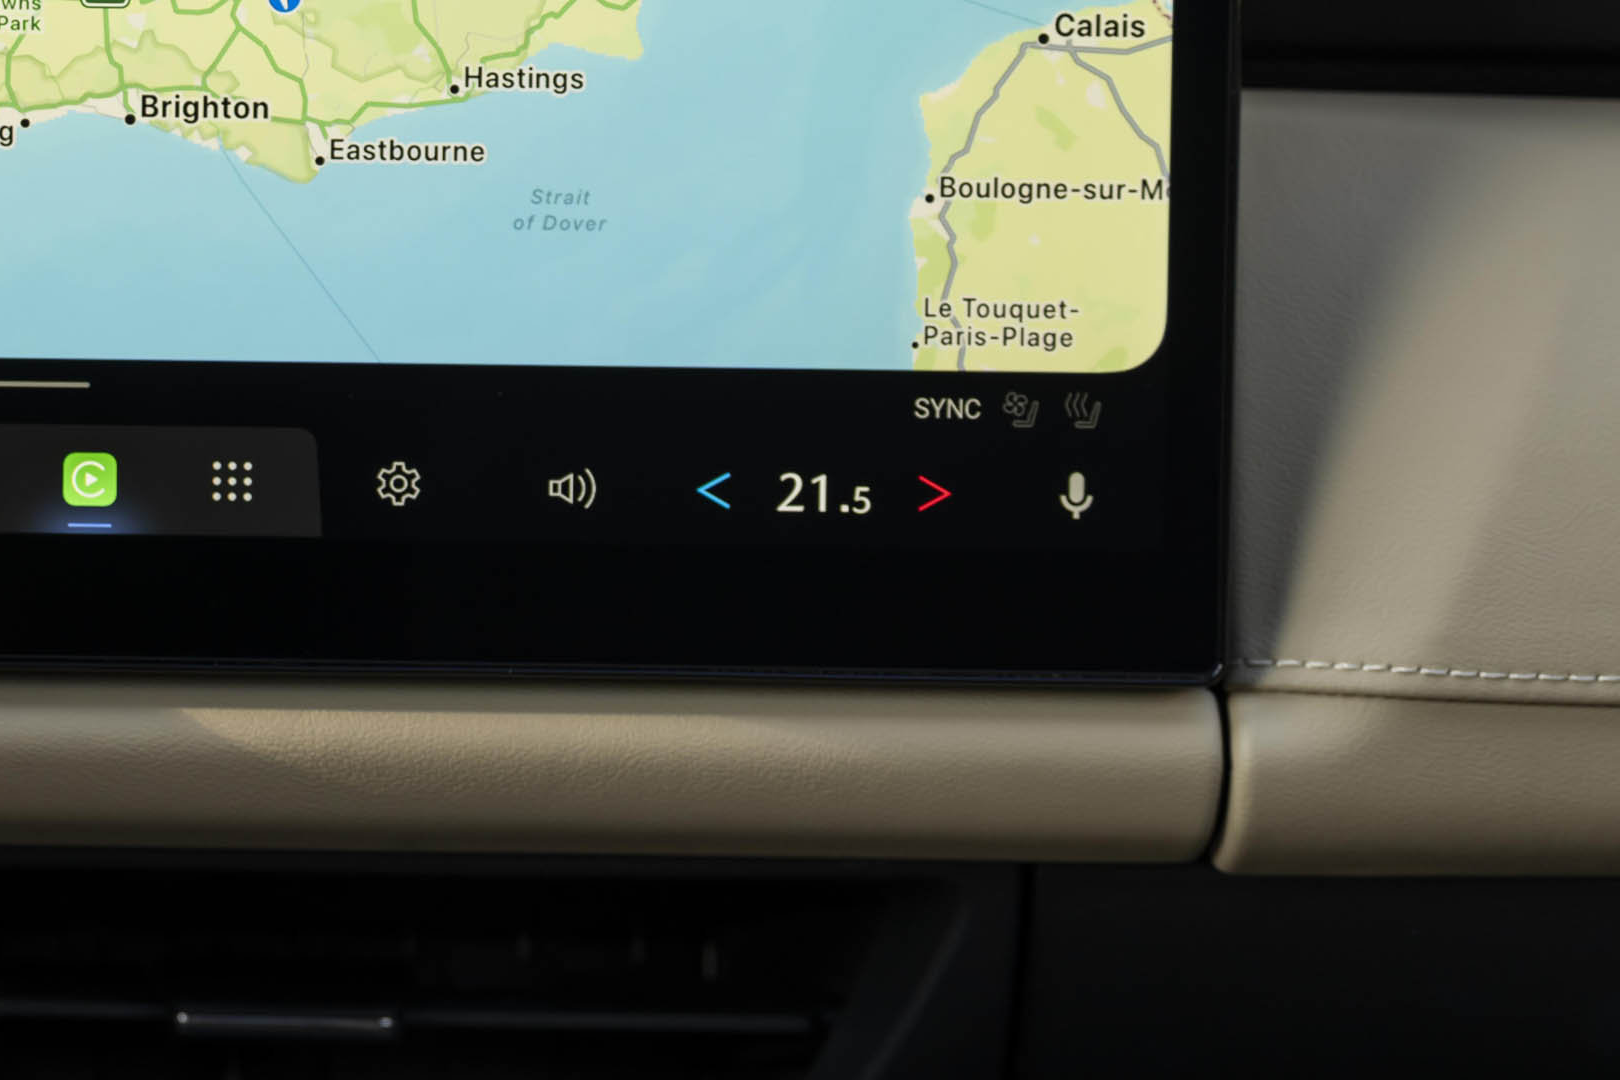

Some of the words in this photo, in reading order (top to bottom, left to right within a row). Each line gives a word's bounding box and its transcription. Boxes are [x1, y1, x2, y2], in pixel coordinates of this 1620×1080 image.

[1055, 13, 1145, 38] Calais
[465, 66, 584, 95] Hastings
[141, 94, 269, 124] Brighton
[330, 138, 485, 162] Eastbourne
[531, 189, 590, 205] Strait
[940, 177, 1170, 204] Boulogne-sur-M
[514, 215, 534, 230] of
[543, 215, 608, 232] Dover
[924, 297, 952, 318] Le
[963, 298, 1078, 322] Touquet-
[925, 326, 1073, 352] Paris-Plage
[914, 398, 981, 420] SYNC
